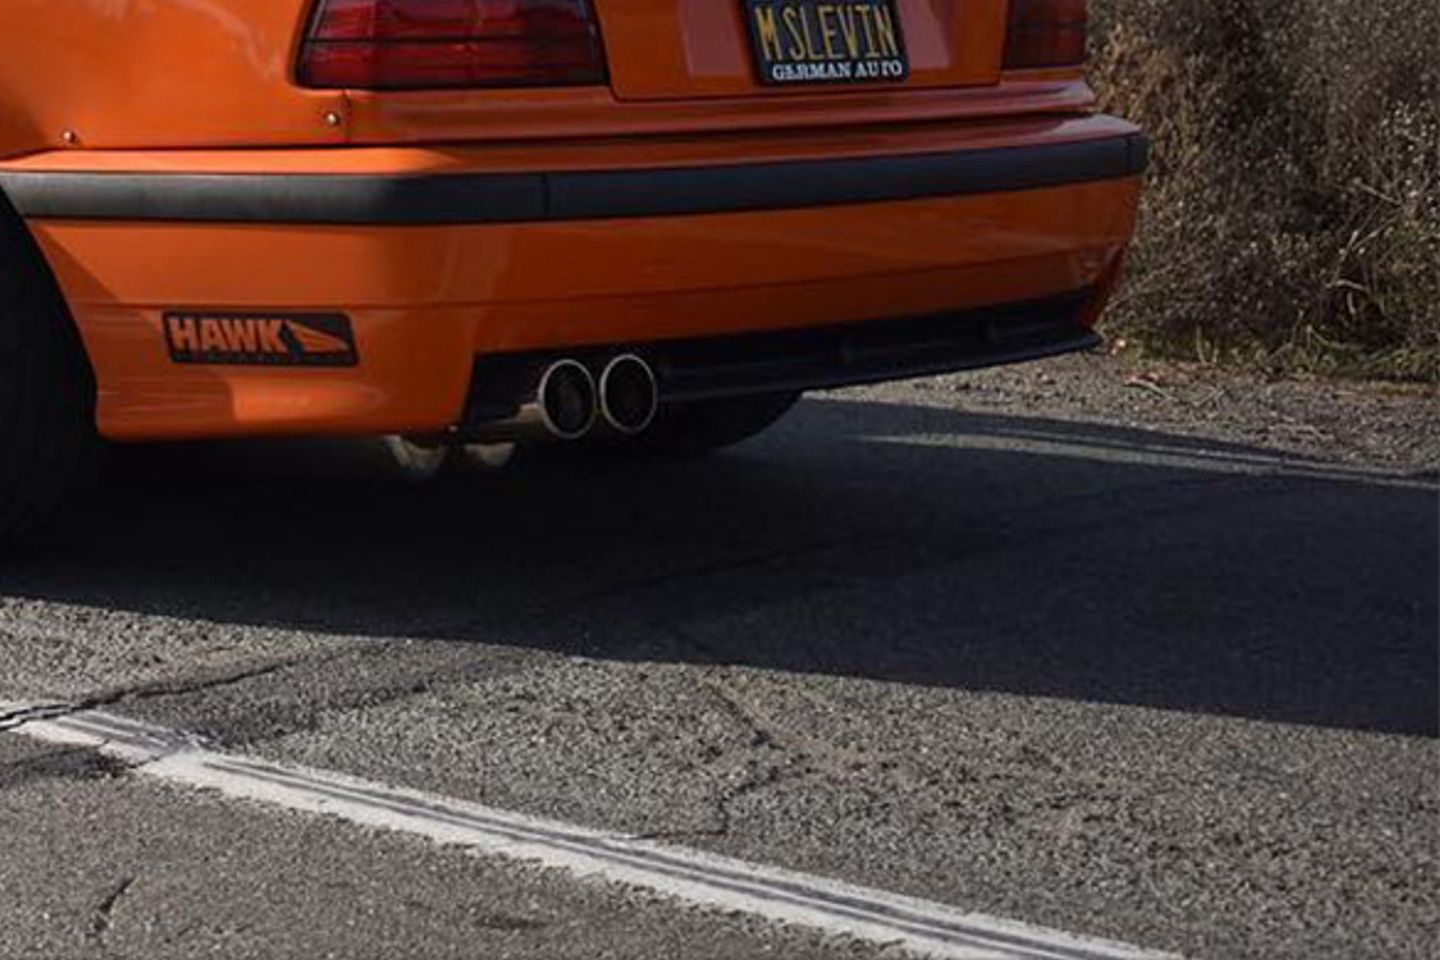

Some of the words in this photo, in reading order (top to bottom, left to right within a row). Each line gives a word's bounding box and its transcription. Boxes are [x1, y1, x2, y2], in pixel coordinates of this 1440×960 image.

[772, 61, 851, 81] GERMAN
[855, 59, 903, 78] AUTO
[168, 317, 289, 353] HAWK
